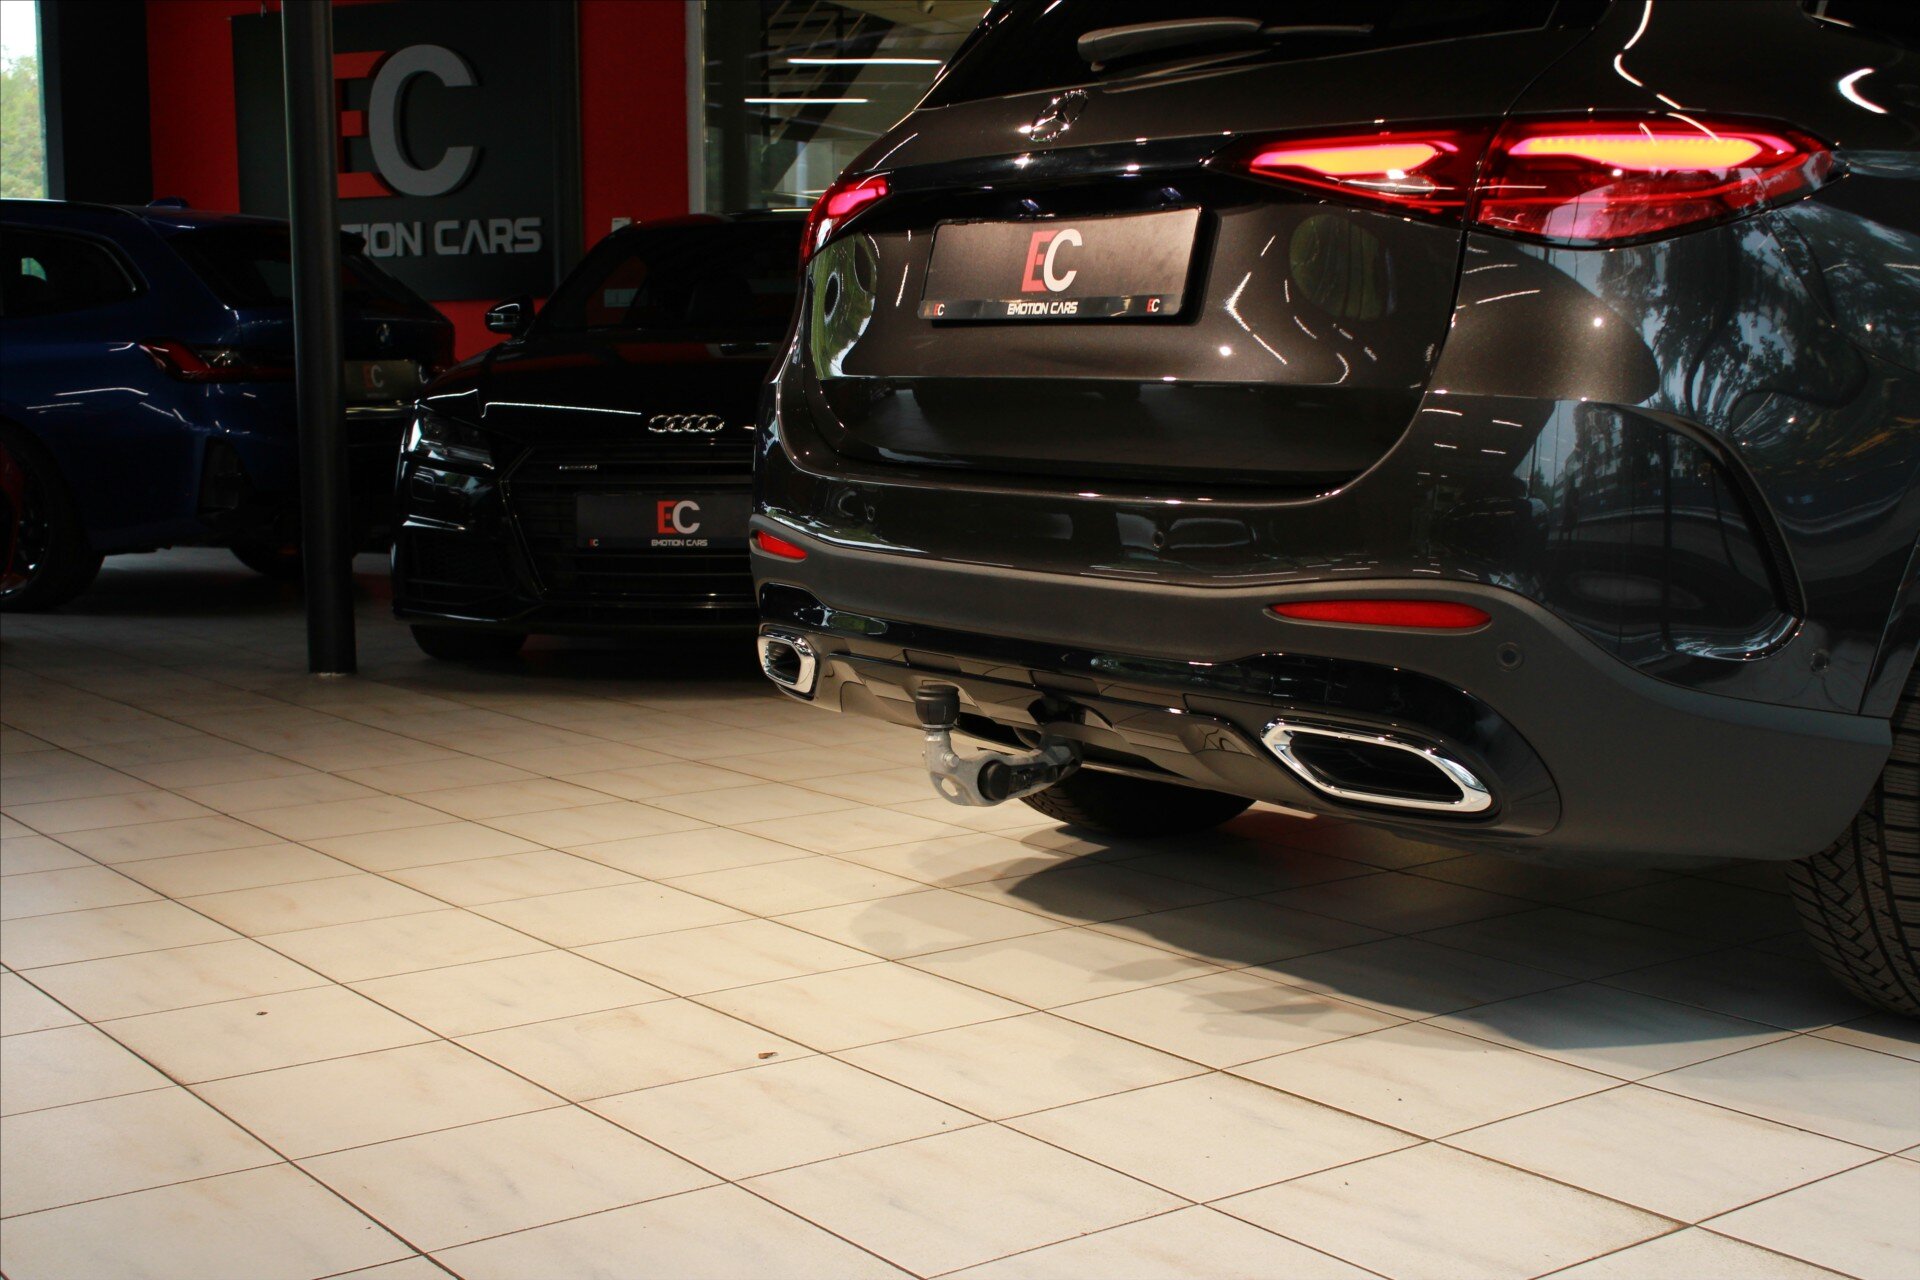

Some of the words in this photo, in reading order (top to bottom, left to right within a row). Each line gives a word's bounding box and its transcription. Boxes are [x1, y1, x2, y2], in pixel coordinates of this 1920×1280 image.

[434, 217, 543, 256] CARS
[1021, 228, 1082, 293] EC
[1007, 302, 1049, 315] EMOTION
[1050, 301, 1079, 315] CARS
[657, 500, 700, 534] EC
